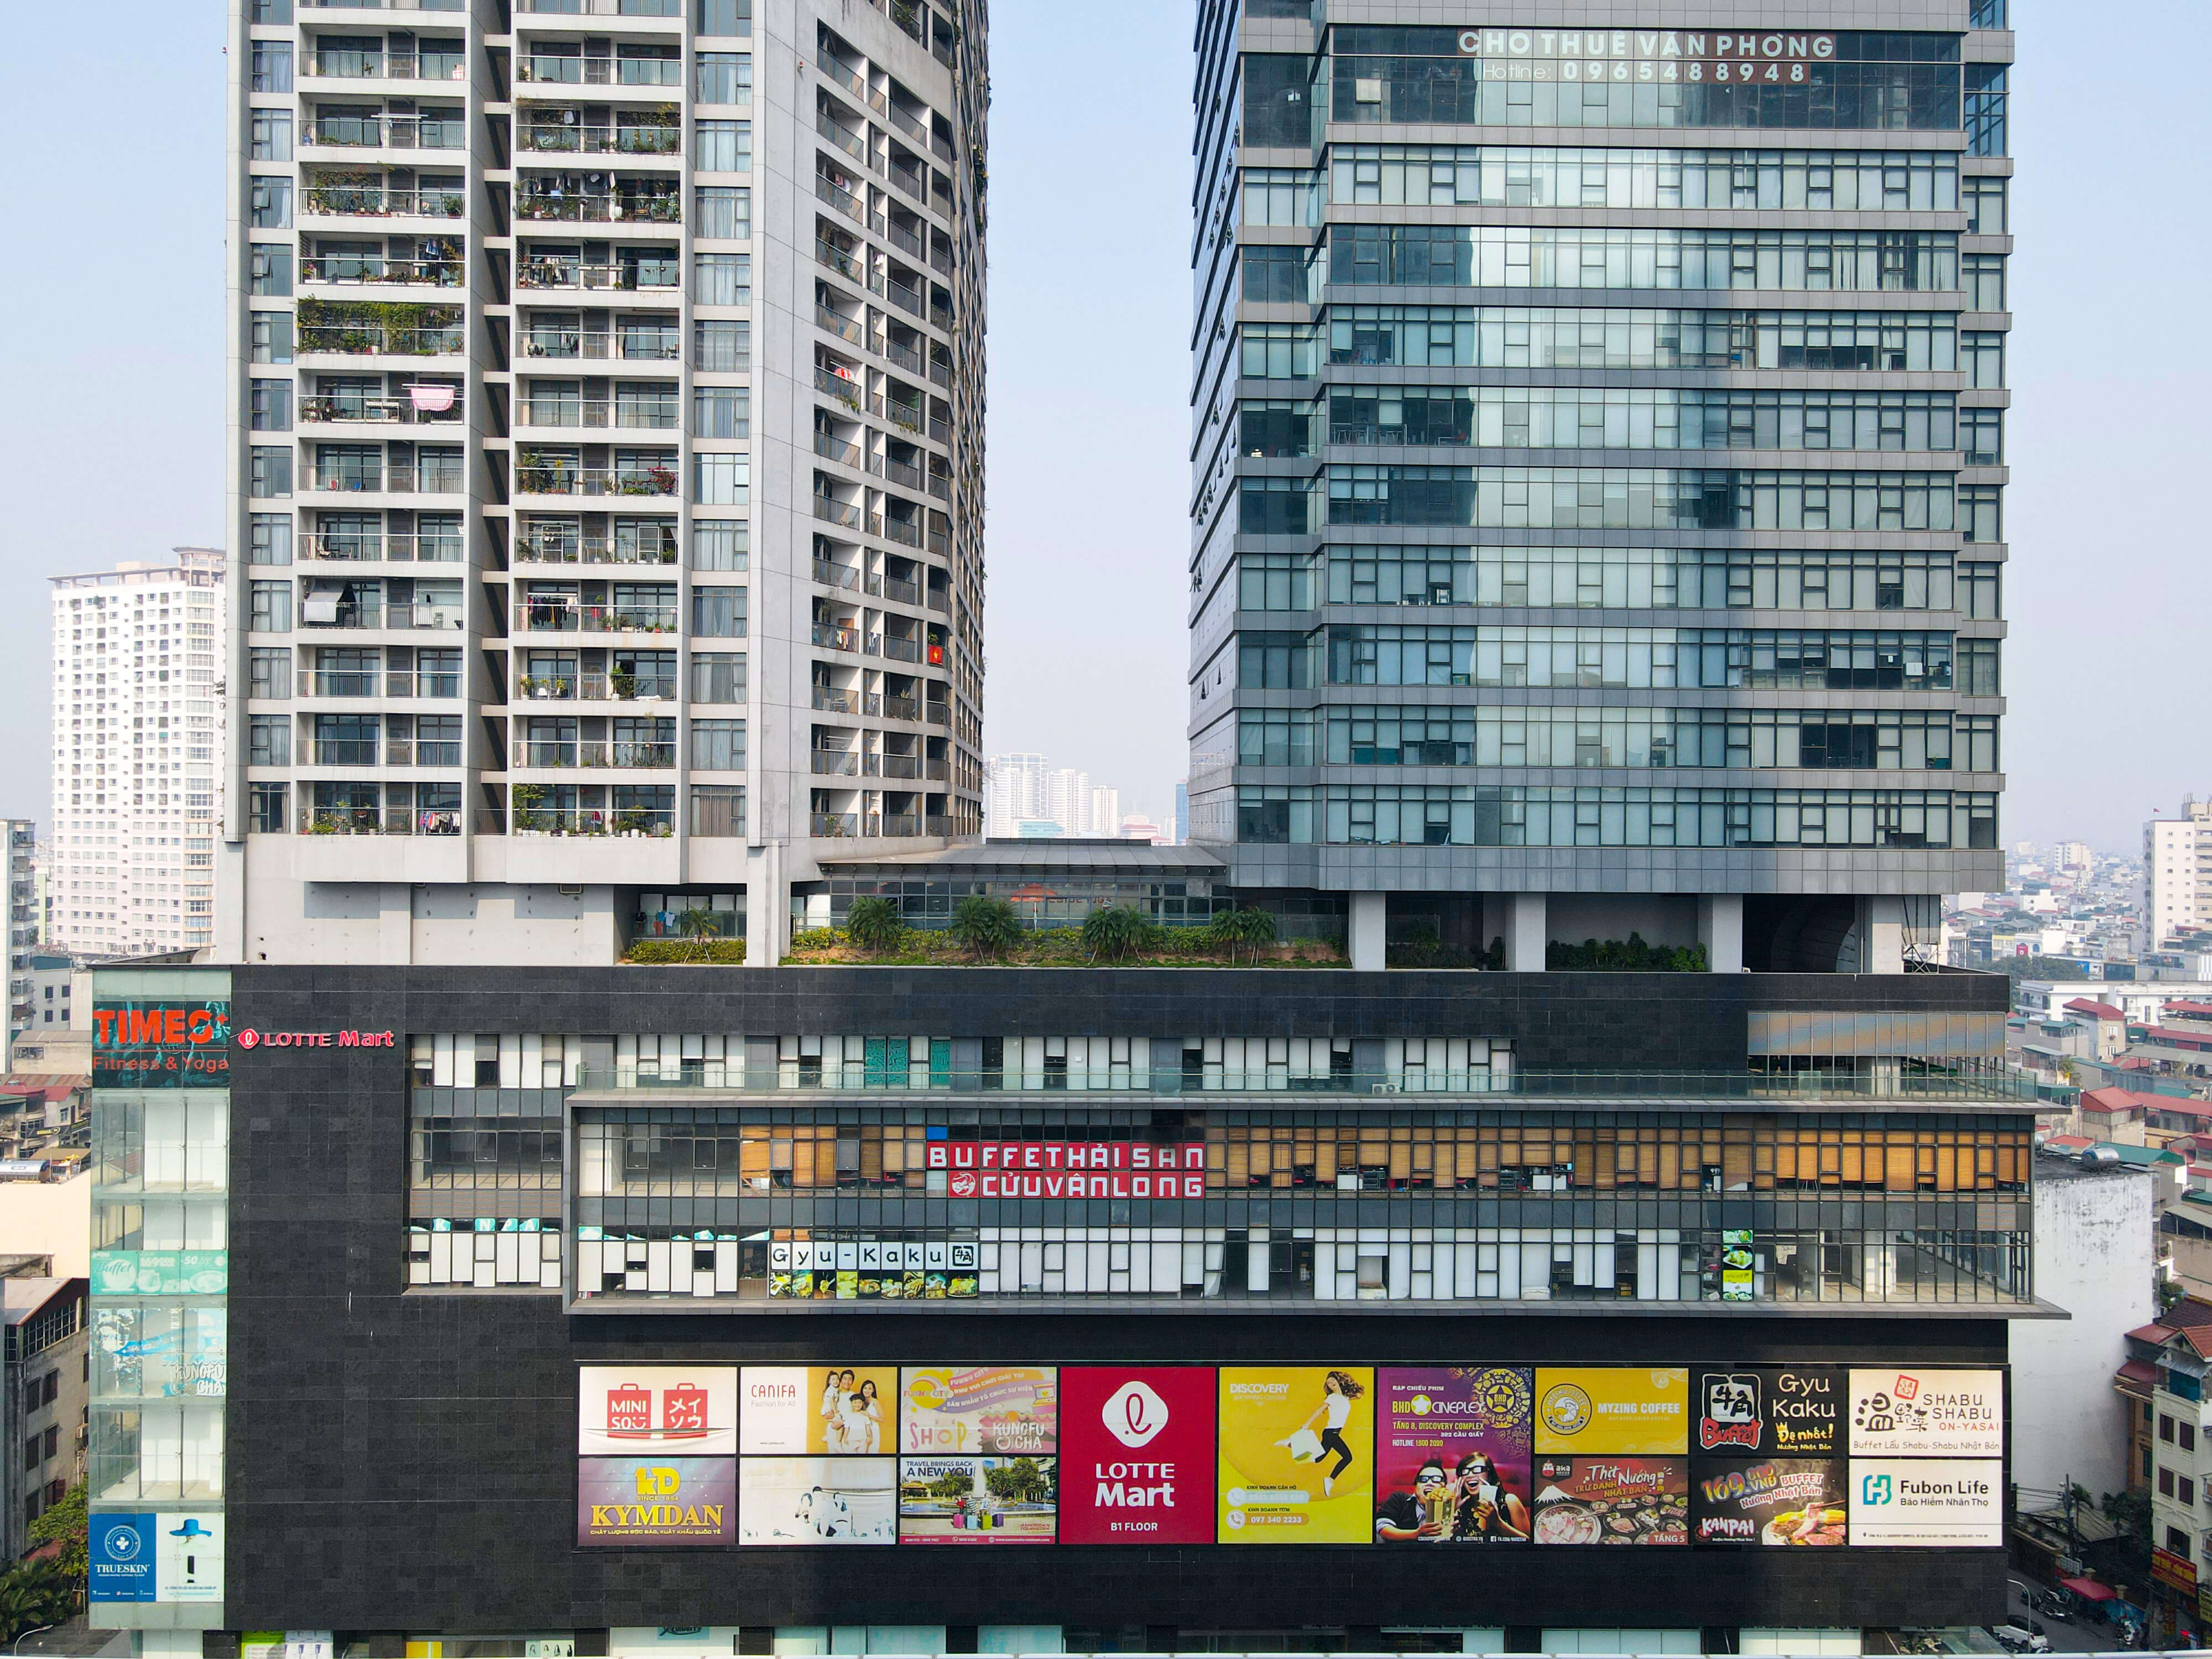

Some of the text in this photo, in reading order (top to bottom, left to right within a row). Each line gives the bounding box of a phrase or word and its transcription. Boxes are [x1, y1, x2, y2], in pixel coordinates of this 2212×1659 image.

[1458, 30, 1834, 58] CHO THUÊ VĂN PHÒNG
[1483, 60, 1804, 82] Hotline: 0965488948
[264, 1030, 394, 1047] LOTTE Mart
[93, 1056, 229, 1073] Fitness & Yoga
[1046, 1172, 1108, 1197] VÂN
[1113, 1177, 1202, 1197] LONG
[197, 1380, 224, 1394] CHA
[752, 1384, 796, 1398] CANIFA
[1229, 1383, 1290, 1394] DISCOVERY
[1778, 1374, 1830, 1397] Gyu
[1494, 1394, 1507, 1402] BHD
[1923, 1394, 1983, 1406] SHABU
[611, 1400, 646, 1413] MINI
[669, 1397, 701, 1414] メイ
[1392, 1401, 1486, 1414] BHD CINEPLEX
[1598, 1402, 1680, 1413] MYZING COFFEE
[1772, 1399, 1836, 1418] Kaku
[1932, 1408, 1992, 1420] SHABU
[993, 1422, 1045, 1437] KUNGFU
[1418, 1422, 1453, 1430] DISCOVERY
[1939, 1422, 2000, 1431] ON-YASAI
[910, 1421, 967, 1452] SHOP
[1015, 1436, 1042, 1451] CHA
[1853, 1441, 1882, 1449] Buffet
[1902, 1441, 1958, 1449] Shabu-Shabu
[1960, 1441, 1981, 1451] Nhật
[1985, 1441, 2000, 1449] Bản
[906, 1467, 973, 1477] A NEW YOU
[1095, 1463, 1175, 1479] LOTTE
[1585, 1464, 1621, 1482] Thịt
[1618, 1467, 1656, 1486] Nướng
[1593, 1480, 1618, 1491] DANH
[1780, 1473, 1824, 1486] BUFFET
[1900, 1480, 1989, 1494] Fubon Life
[1094, 1482, 1175, 1507] Mart
[1921, 1496, 1944, 1506] Hiểm
[1946, 1498, 1969, 1506] Nhân
[1972, 1498, 1989, 1508] Thọ
[590, 1505, 724, 1527] KYMDAN
[1110, 1522, 1158, 1531] B1 FLOOR
[1701, 1516, 1754, 1536] KANPAI
[95, 1564, 148, 1573] TRUESKIN
